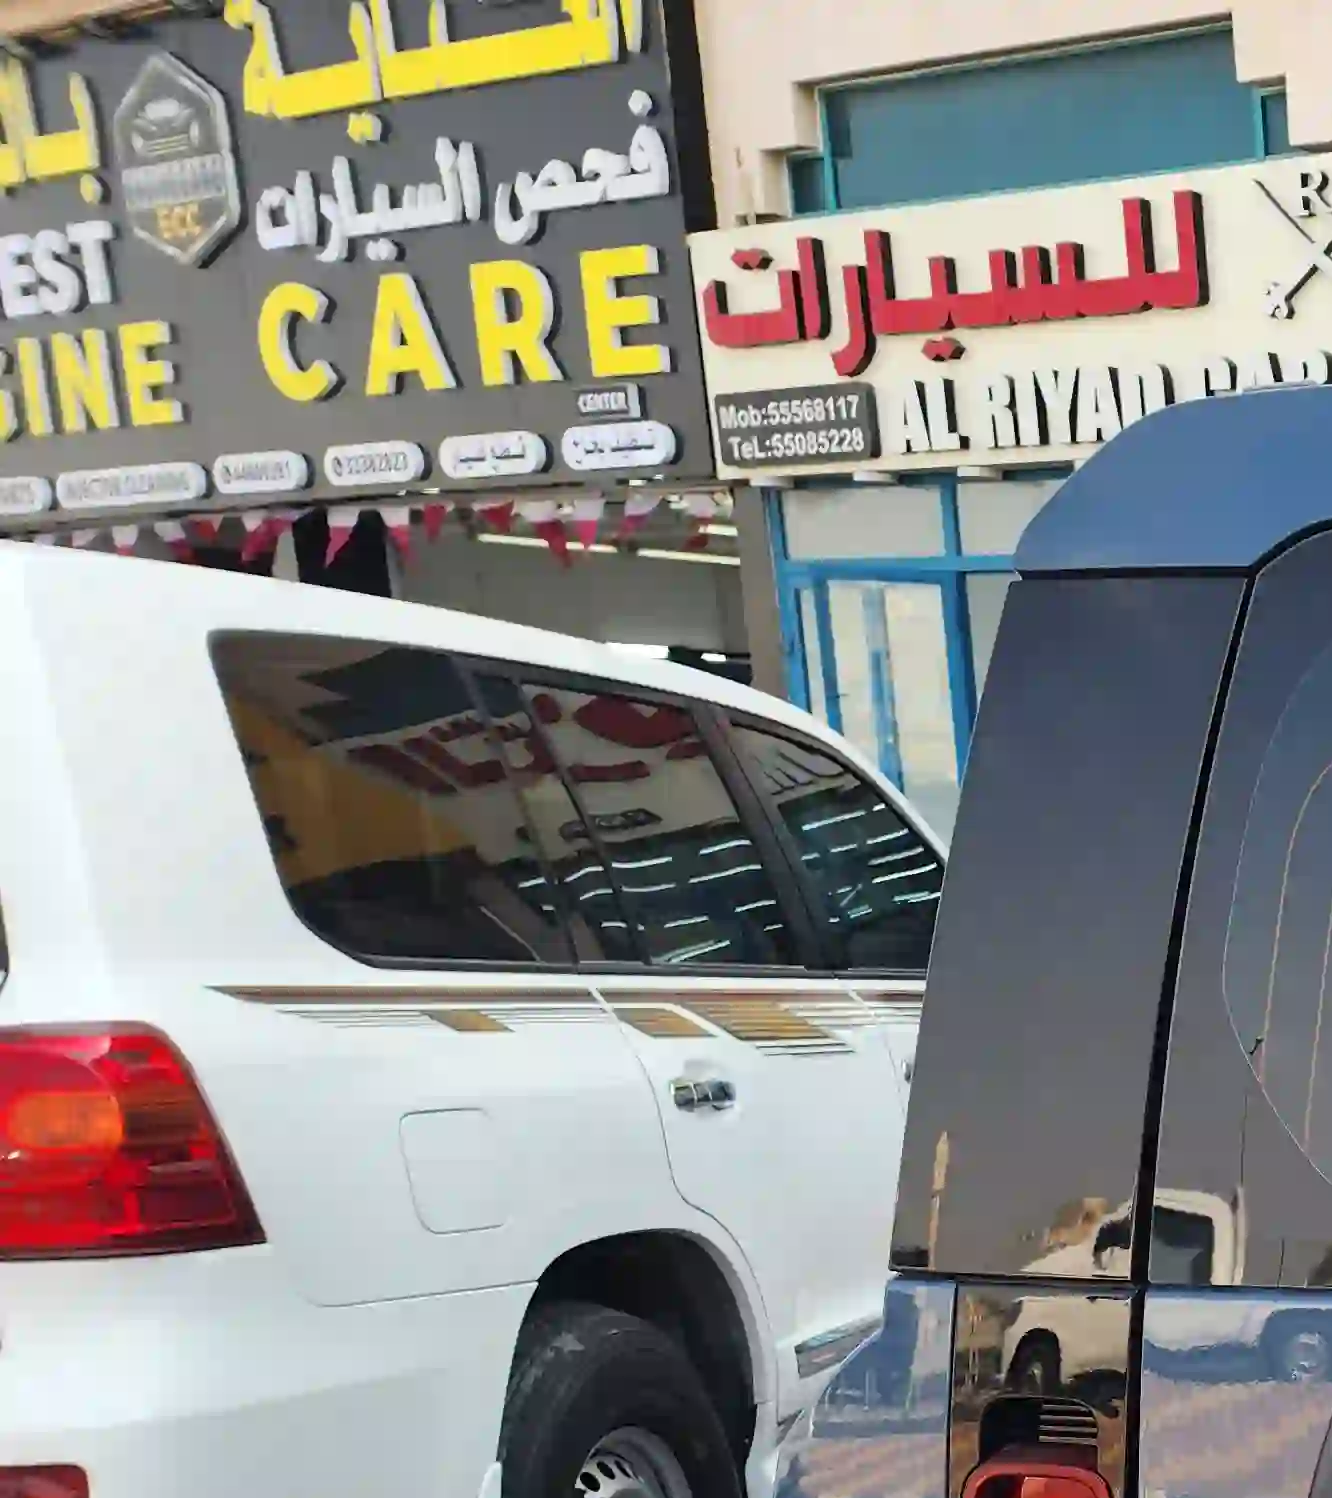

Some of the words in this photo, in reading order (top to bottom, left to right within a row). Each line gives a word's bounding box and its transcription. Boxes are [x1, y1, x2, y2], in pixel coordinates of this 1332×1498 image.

[494, 89, 669, 245] فحص
[257, 244, 672, 401] CARE
[702, 189, 1211, 378] للسيارات
[0, 319, 185, 441] INE
[718, 394, 860, 429] Mob:55568117
[899, 376, 970, 454] AL
[727, 427, 865, 461] TeL:55085228
